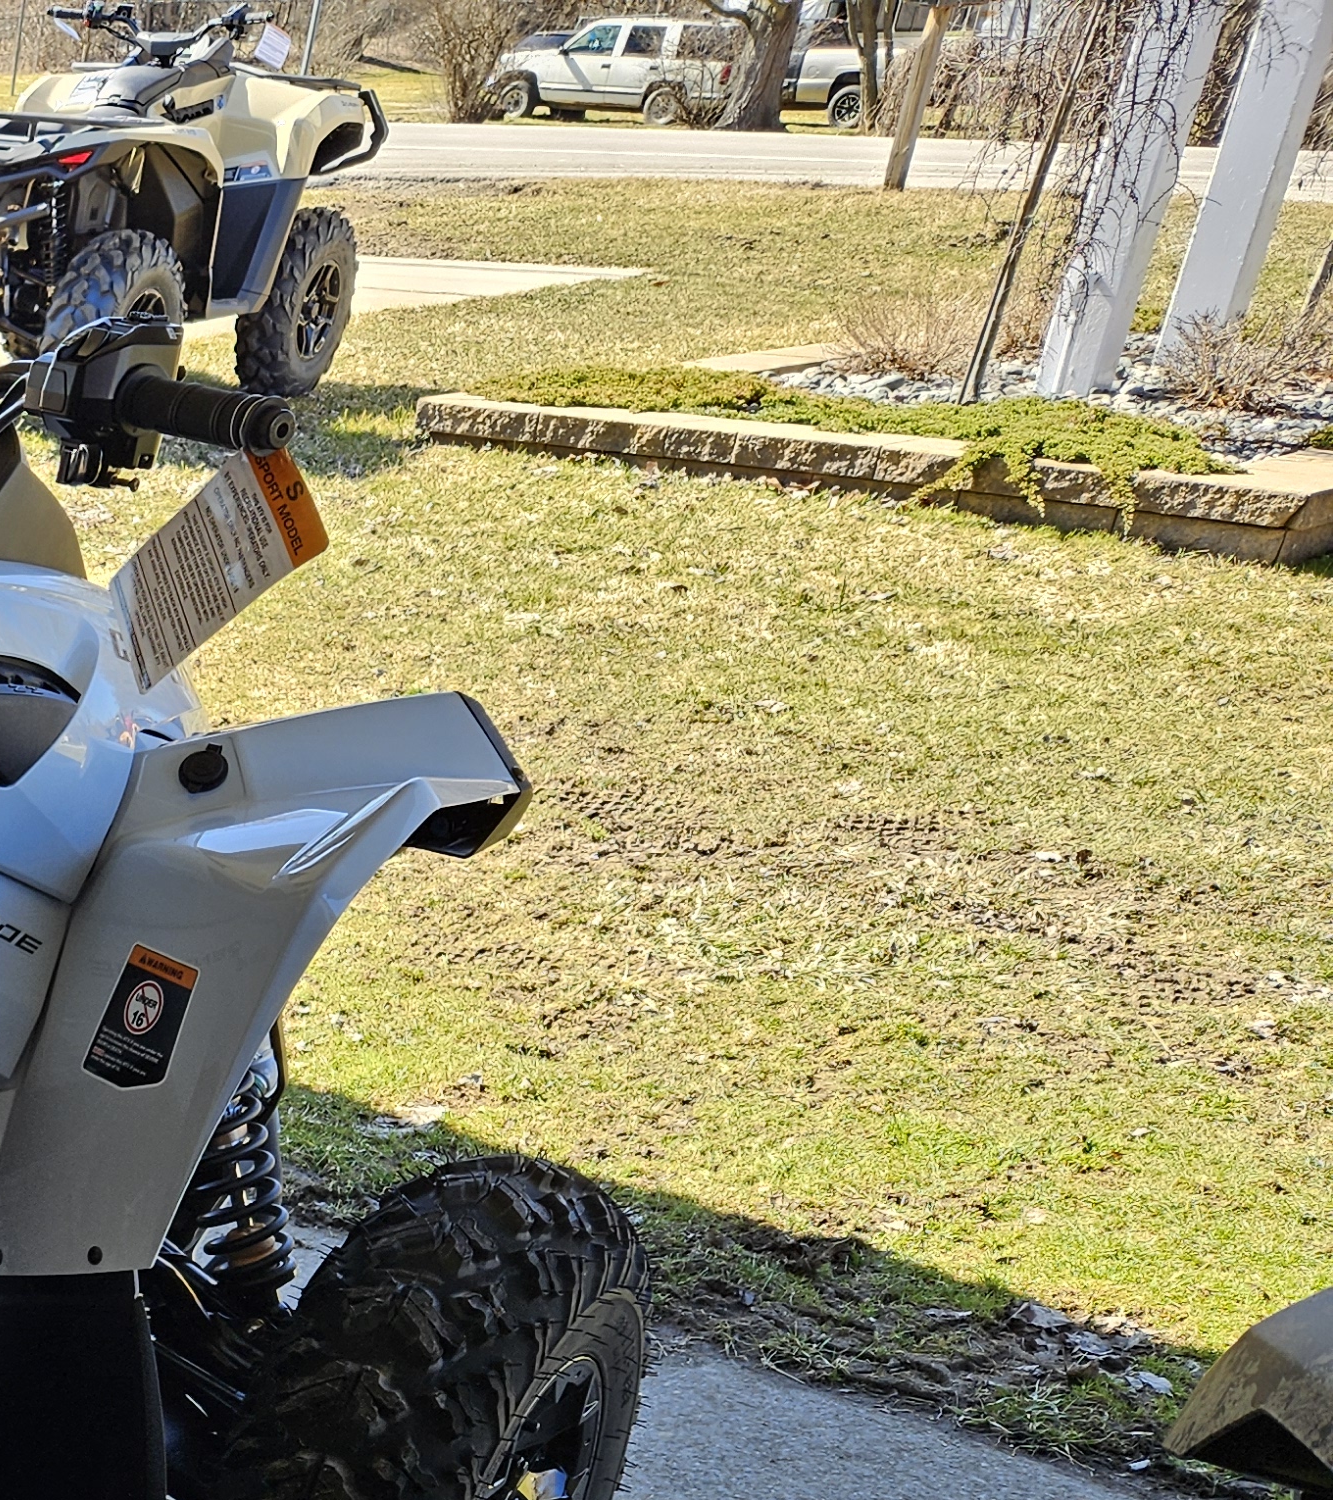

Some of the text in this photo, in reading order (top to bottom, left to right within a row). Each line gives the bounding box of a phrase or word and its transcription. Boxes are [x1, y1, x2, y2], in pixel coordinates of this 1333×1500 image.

[285, 480, 304, 502] S
[254, 457, 304, 556] SPORT MODEL
[256, 504, 264, 518] ATV
[204, 505, 212, 518] NO
[208, 515, 224, 550] OPERATOR
[260, 514, 267, 523] IS
[263, 521, 272, 535] FOR
[258, 533, 268, 550] USE
[245, 524, 263, 562] OPERATORS
[258, 559, 270, 580] ONLY
[145, 958, 184, 981] WARNING
[134, 993, 158, 1011] UNDER
[131, 1009, 145, 1028] 16
